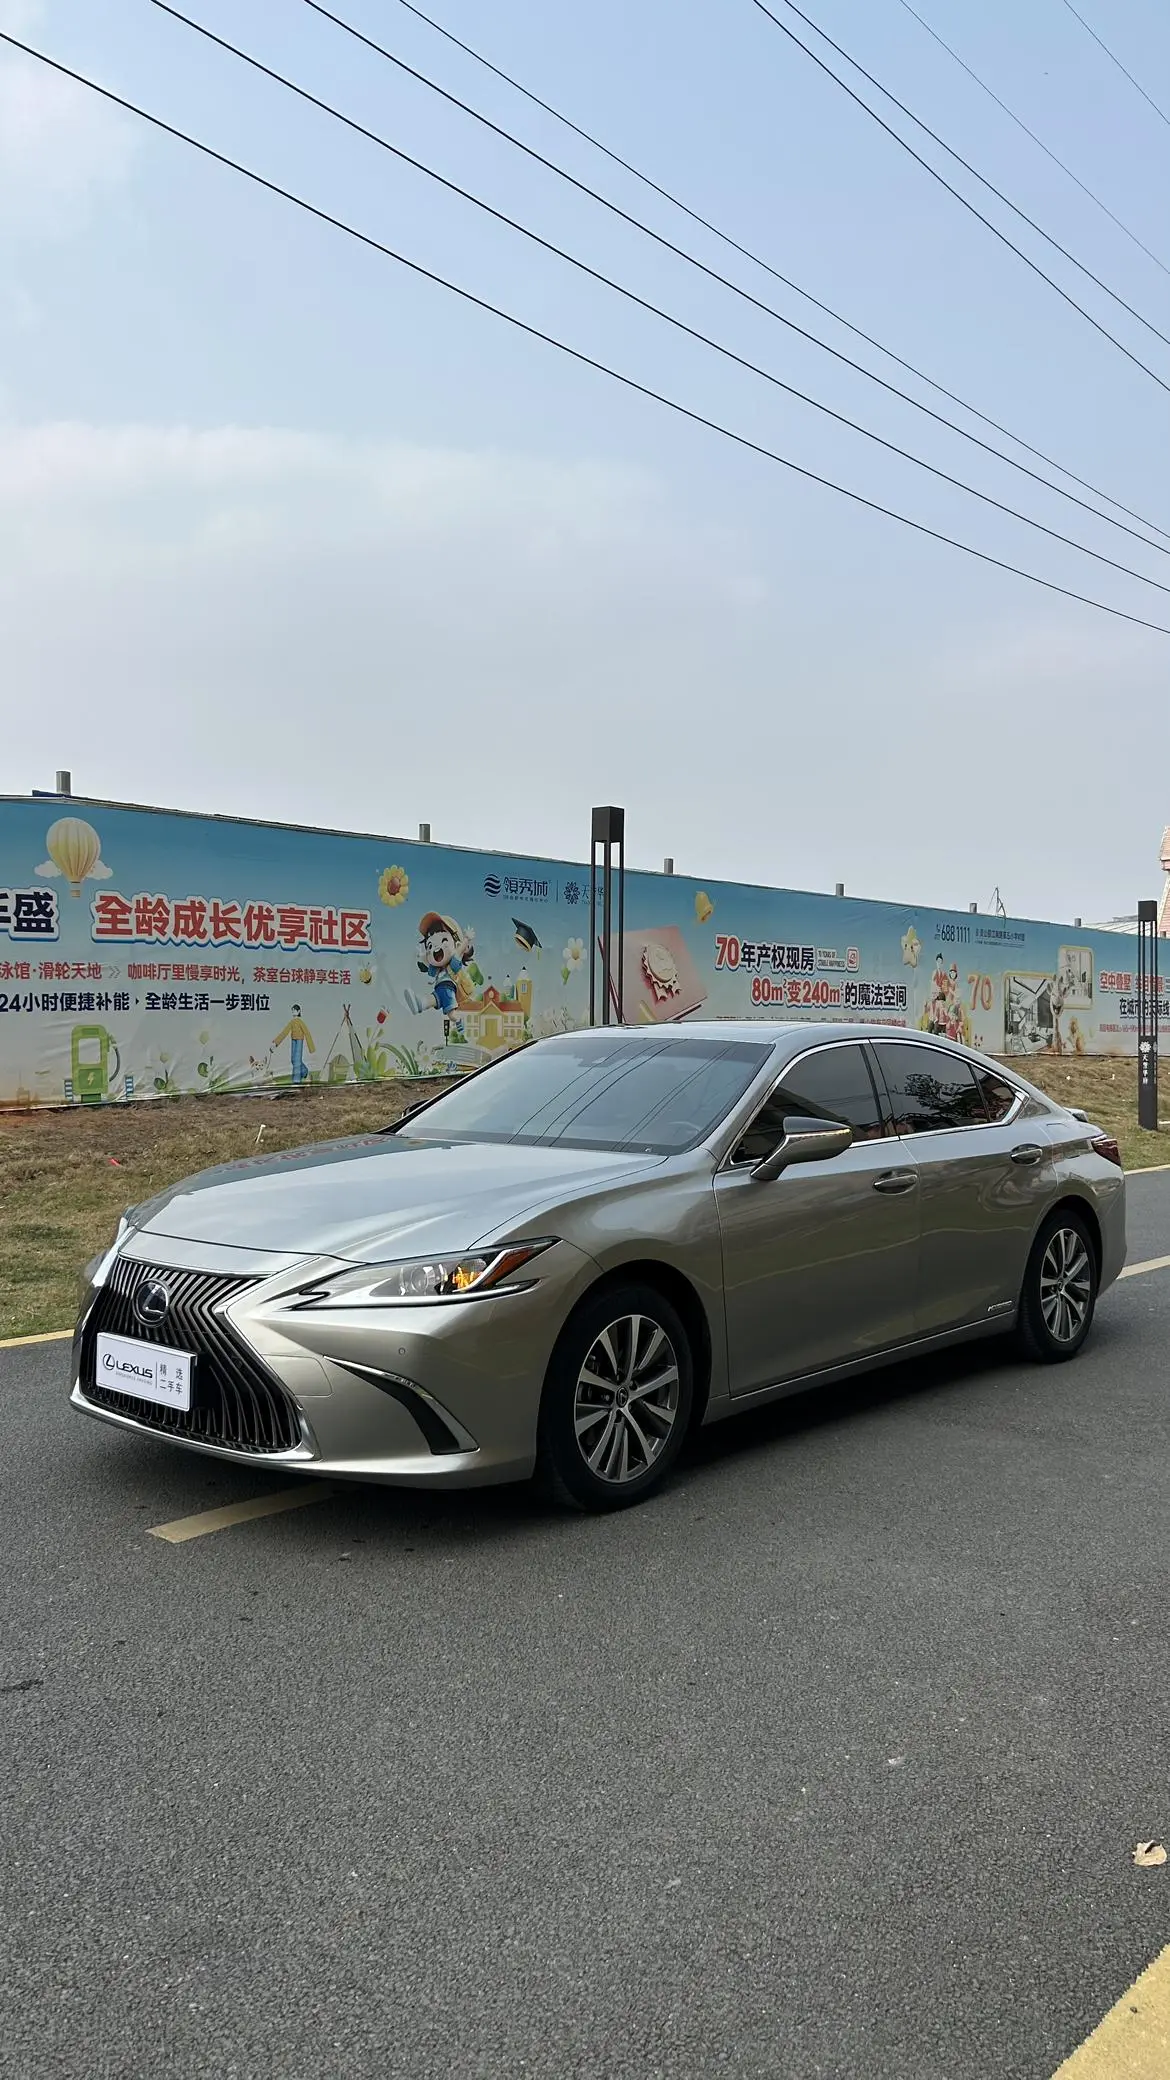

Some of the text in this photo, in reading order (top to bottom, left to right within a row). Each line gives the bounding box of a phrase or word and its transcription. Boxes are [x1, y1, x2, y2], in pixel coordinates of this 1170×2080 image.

[95, 895, 369, 947] 全龄成长优享社区
[941, 924, 970, 943] 6881111
[716, 937, 814, 970] 70年产权现房
[145, 992, 270, 1011] 全龄生活一步到位
[968, 974, 993, 1011] 70
[116, 1360, 153, 1379] LEXUS
[160, 1378, 183, 1395] 二手车
